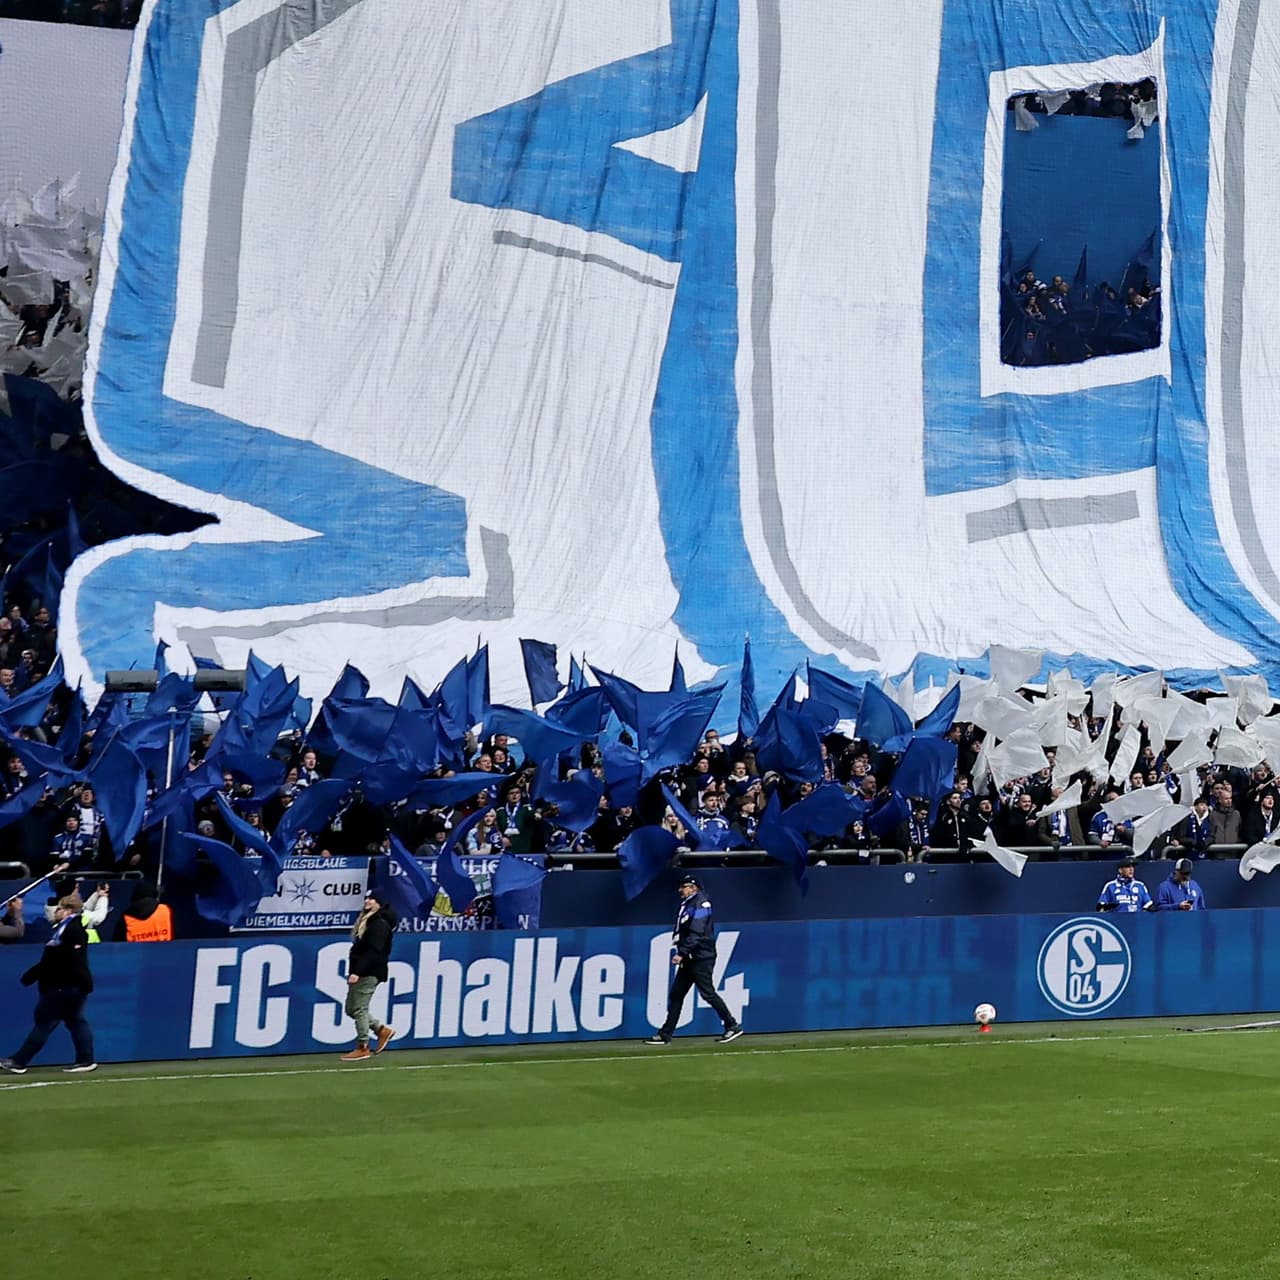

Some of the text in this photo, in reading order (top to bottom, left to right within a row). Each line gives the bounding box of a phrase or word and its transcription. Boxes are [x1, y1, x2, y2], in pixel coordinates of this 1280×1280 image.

[323, 883, 362, 896] CLUB
[190, 945, 292, 1048] FC
[311, 938, 625, 1044] Schalke
